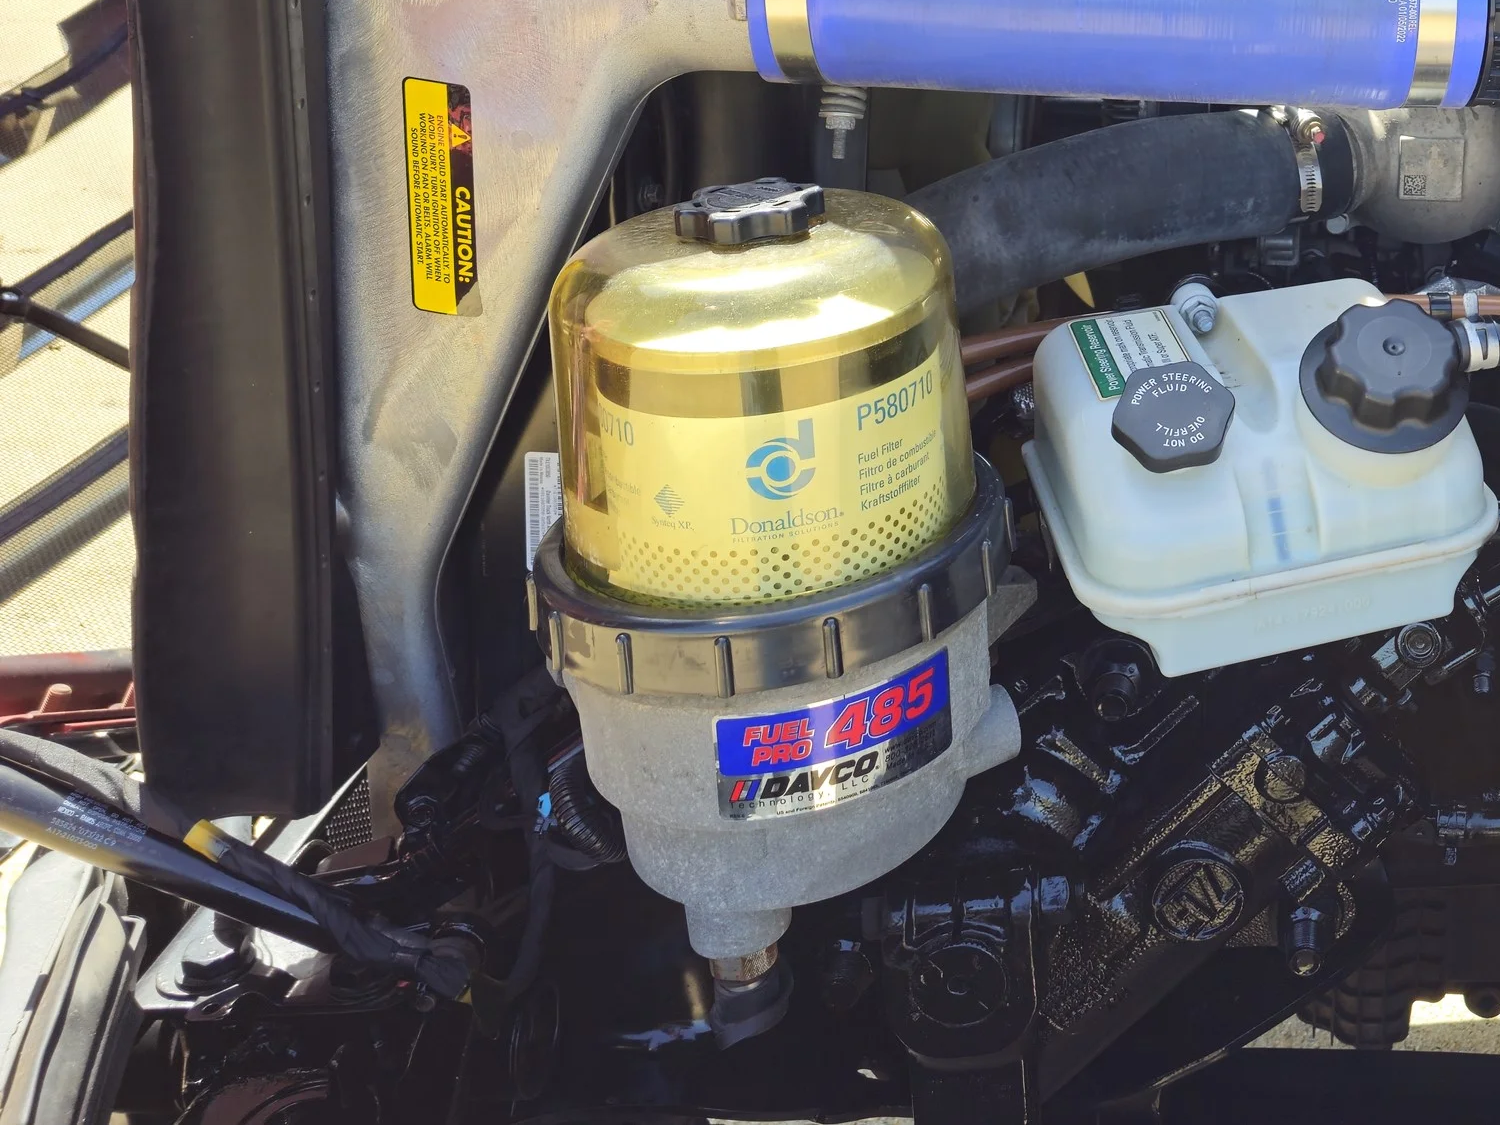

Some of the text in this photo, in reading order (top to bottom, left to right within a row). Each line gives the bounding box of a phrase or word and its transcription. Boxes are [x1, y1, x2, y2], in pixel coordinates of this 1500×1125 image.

[419, 112, 427, 155] WORKING
[436, 115, 445, 147] ENGINE
[420, 156, 429, 171] ON
[438, 148, 447, 177] COULD
[421, 172, 430, 190] FAN
[439, 178, 448, 202] START
[411, 127, 424, 264] SOUND BEFORE AUTOMATIC START.
[422, 191, 430, 204] OR
[427, 113, 442, 282] AVOID INJURY, TURN IGNITION OFF WHEN
[423, 207, 431, 229] BELTS.
[424, 232, 433, 260] ALARM
[455, 186, 473, 283] CAUTION:
[443, 273, 450, 284] TO
[1123, 319, 1133, 330] Fluid
[1115, 342, 1127, 353] mark
[1129, 329, 1148, 355] Transmission
[1155, 342, 1167, 354] Super
[1081, 325, 1120, 391] Power Steering Reservoir
[857, 369, 933, 431] P580710
[1131, 373, 1212, 405] POWER STEERING
[1152, 383, 1187, 397] FLUID
[1155, 416, 1205, 437] OVERFILL
[1163, 432, 1205, 447] DO NOT
[857, 437, 903, 464] Fuel Filter
[859, 429, 937, 480] Filtro de combustible
[860, 451, 930, 495] Filtre à carburant
[861, 475, 921, 511] Kraftstofffilter
[651, 516, 676, 530] Synteq
[730, 506, 838, 535] Donaldson
[732, 521, 839, 543] FILTRATION SOLUTIONS
[824, 667, 934, 749] 485
[743, 718, 815, 747] FUEL
[752, 739, 812, 766] PRO
[760, 750, 879, 800] DAVCO
[796, 804, 816, 814] Foreign
